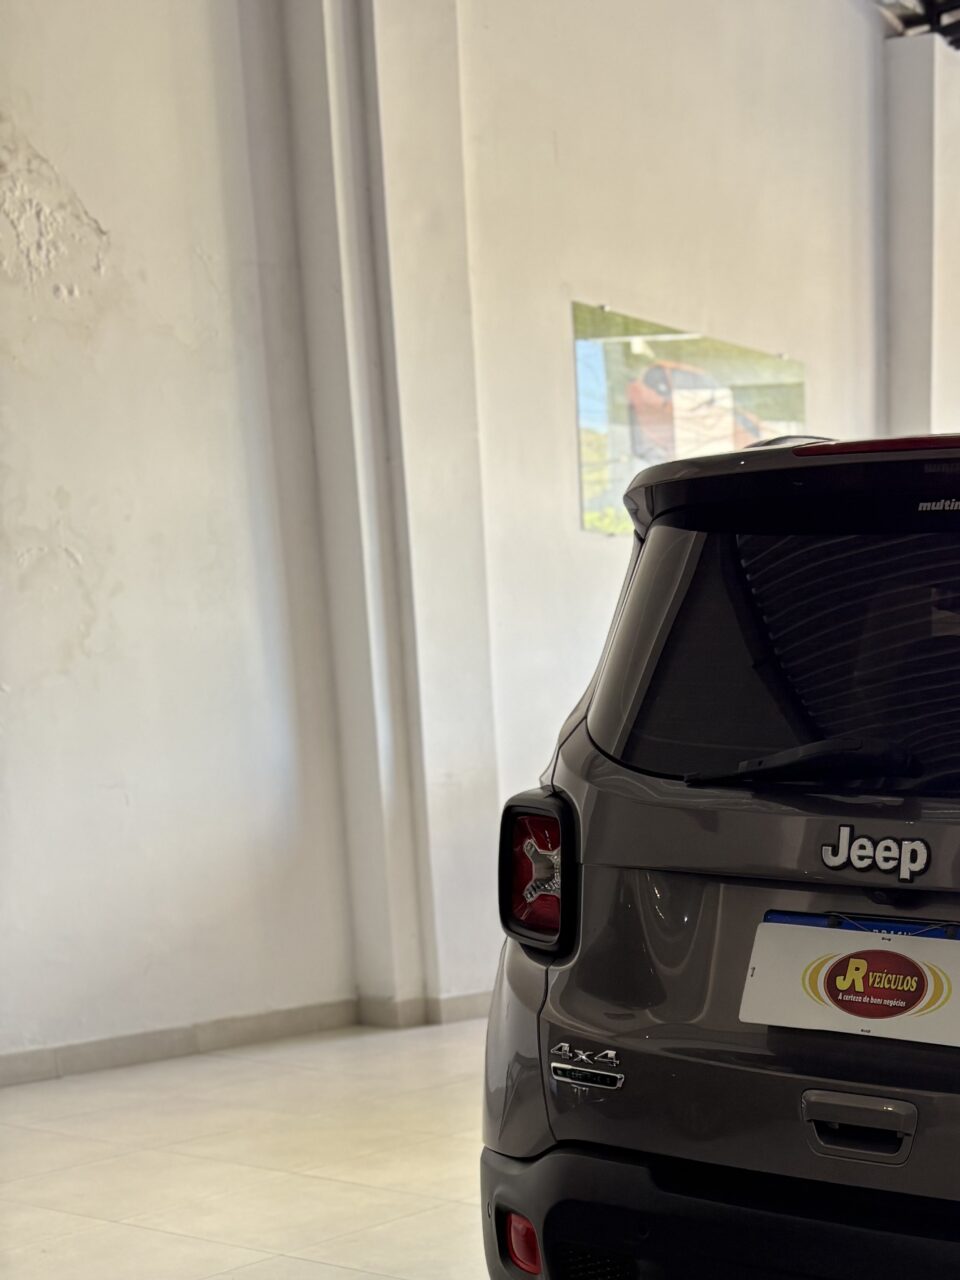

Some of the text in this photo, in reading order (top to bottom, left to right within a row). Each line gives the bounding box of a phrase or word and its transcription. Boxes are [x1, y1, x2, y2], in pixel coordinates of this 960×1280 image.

[821, 825, 930, 882] Jeep
[835, 957, 918, 993] JR VEÍCULOS
[862, 995, 870, 1004] de
